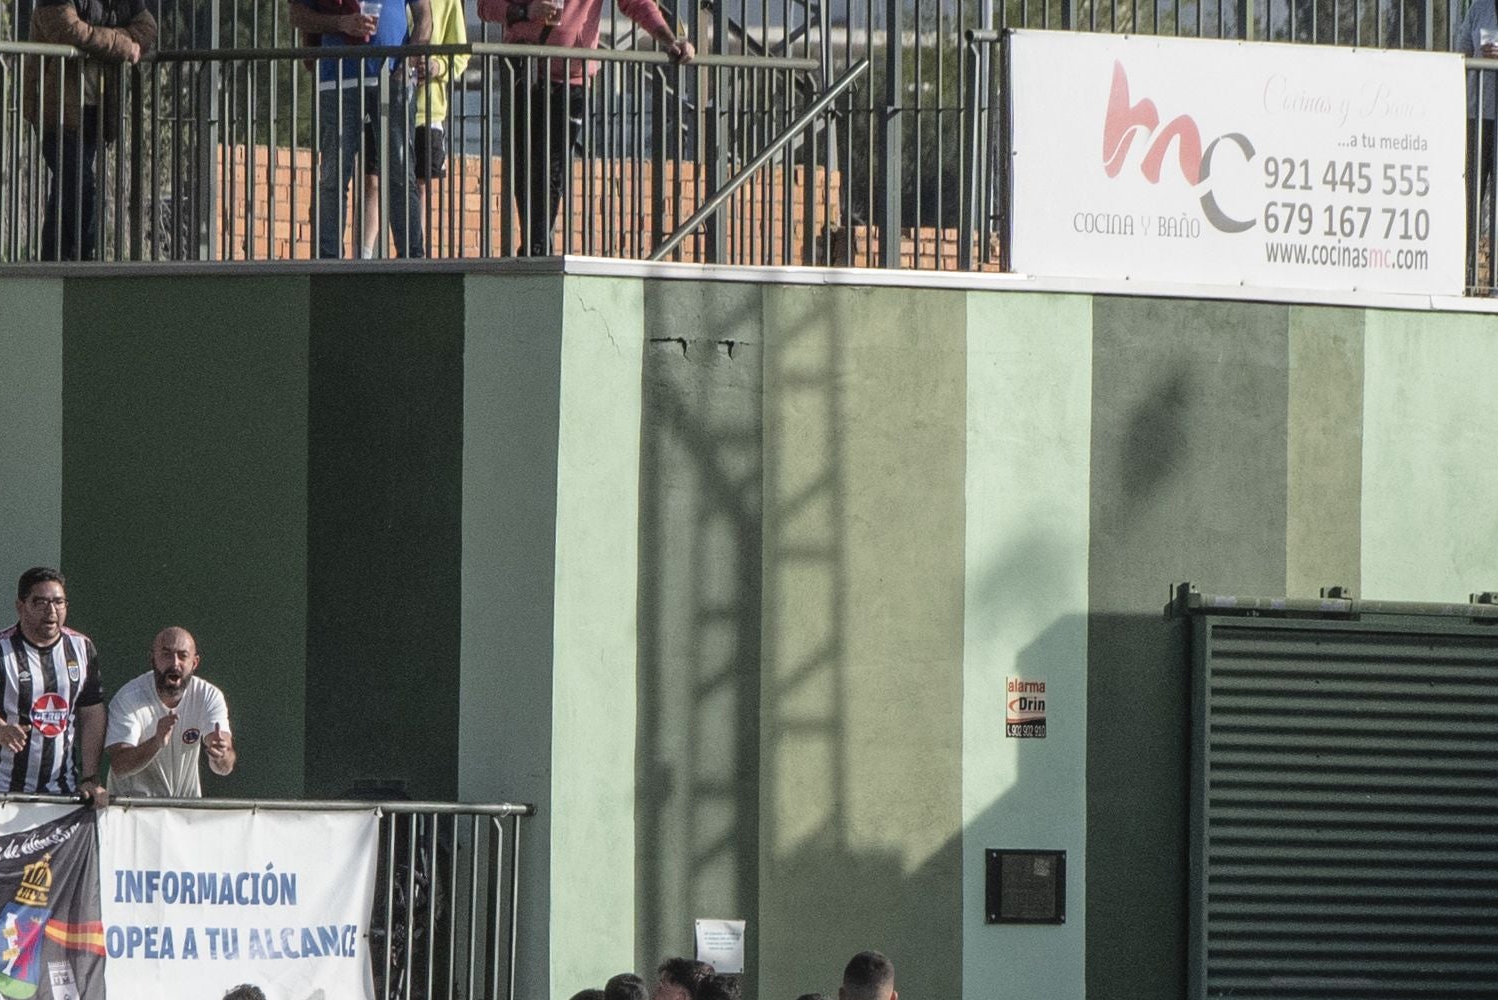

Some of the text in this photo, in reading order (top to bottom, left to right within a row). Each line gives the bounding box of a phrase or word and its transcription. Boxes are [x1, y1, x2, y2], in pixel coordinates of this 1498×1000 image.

[1362, 133, 1375, 148] tu
[1380, 134, 1428, 151] medida
[1264, 156, 1430, 197] 921 445 555
[1074, 212, 1200, 238] COCINA Y BAÑO
[1264, 201, 1430, 241] 679 167 710
[1265, 238, 1429, 270] www.cocinasmc.com
[1008, 678, 1045, 692] alarma
[1019, 696, 1045, 711] Drin
[4, 839, 20, 859] de
[114, 861, 297, 905] INFORMACIÓN
[182, 927, 199, 960] A
[205, 927, 239, 960] TU
